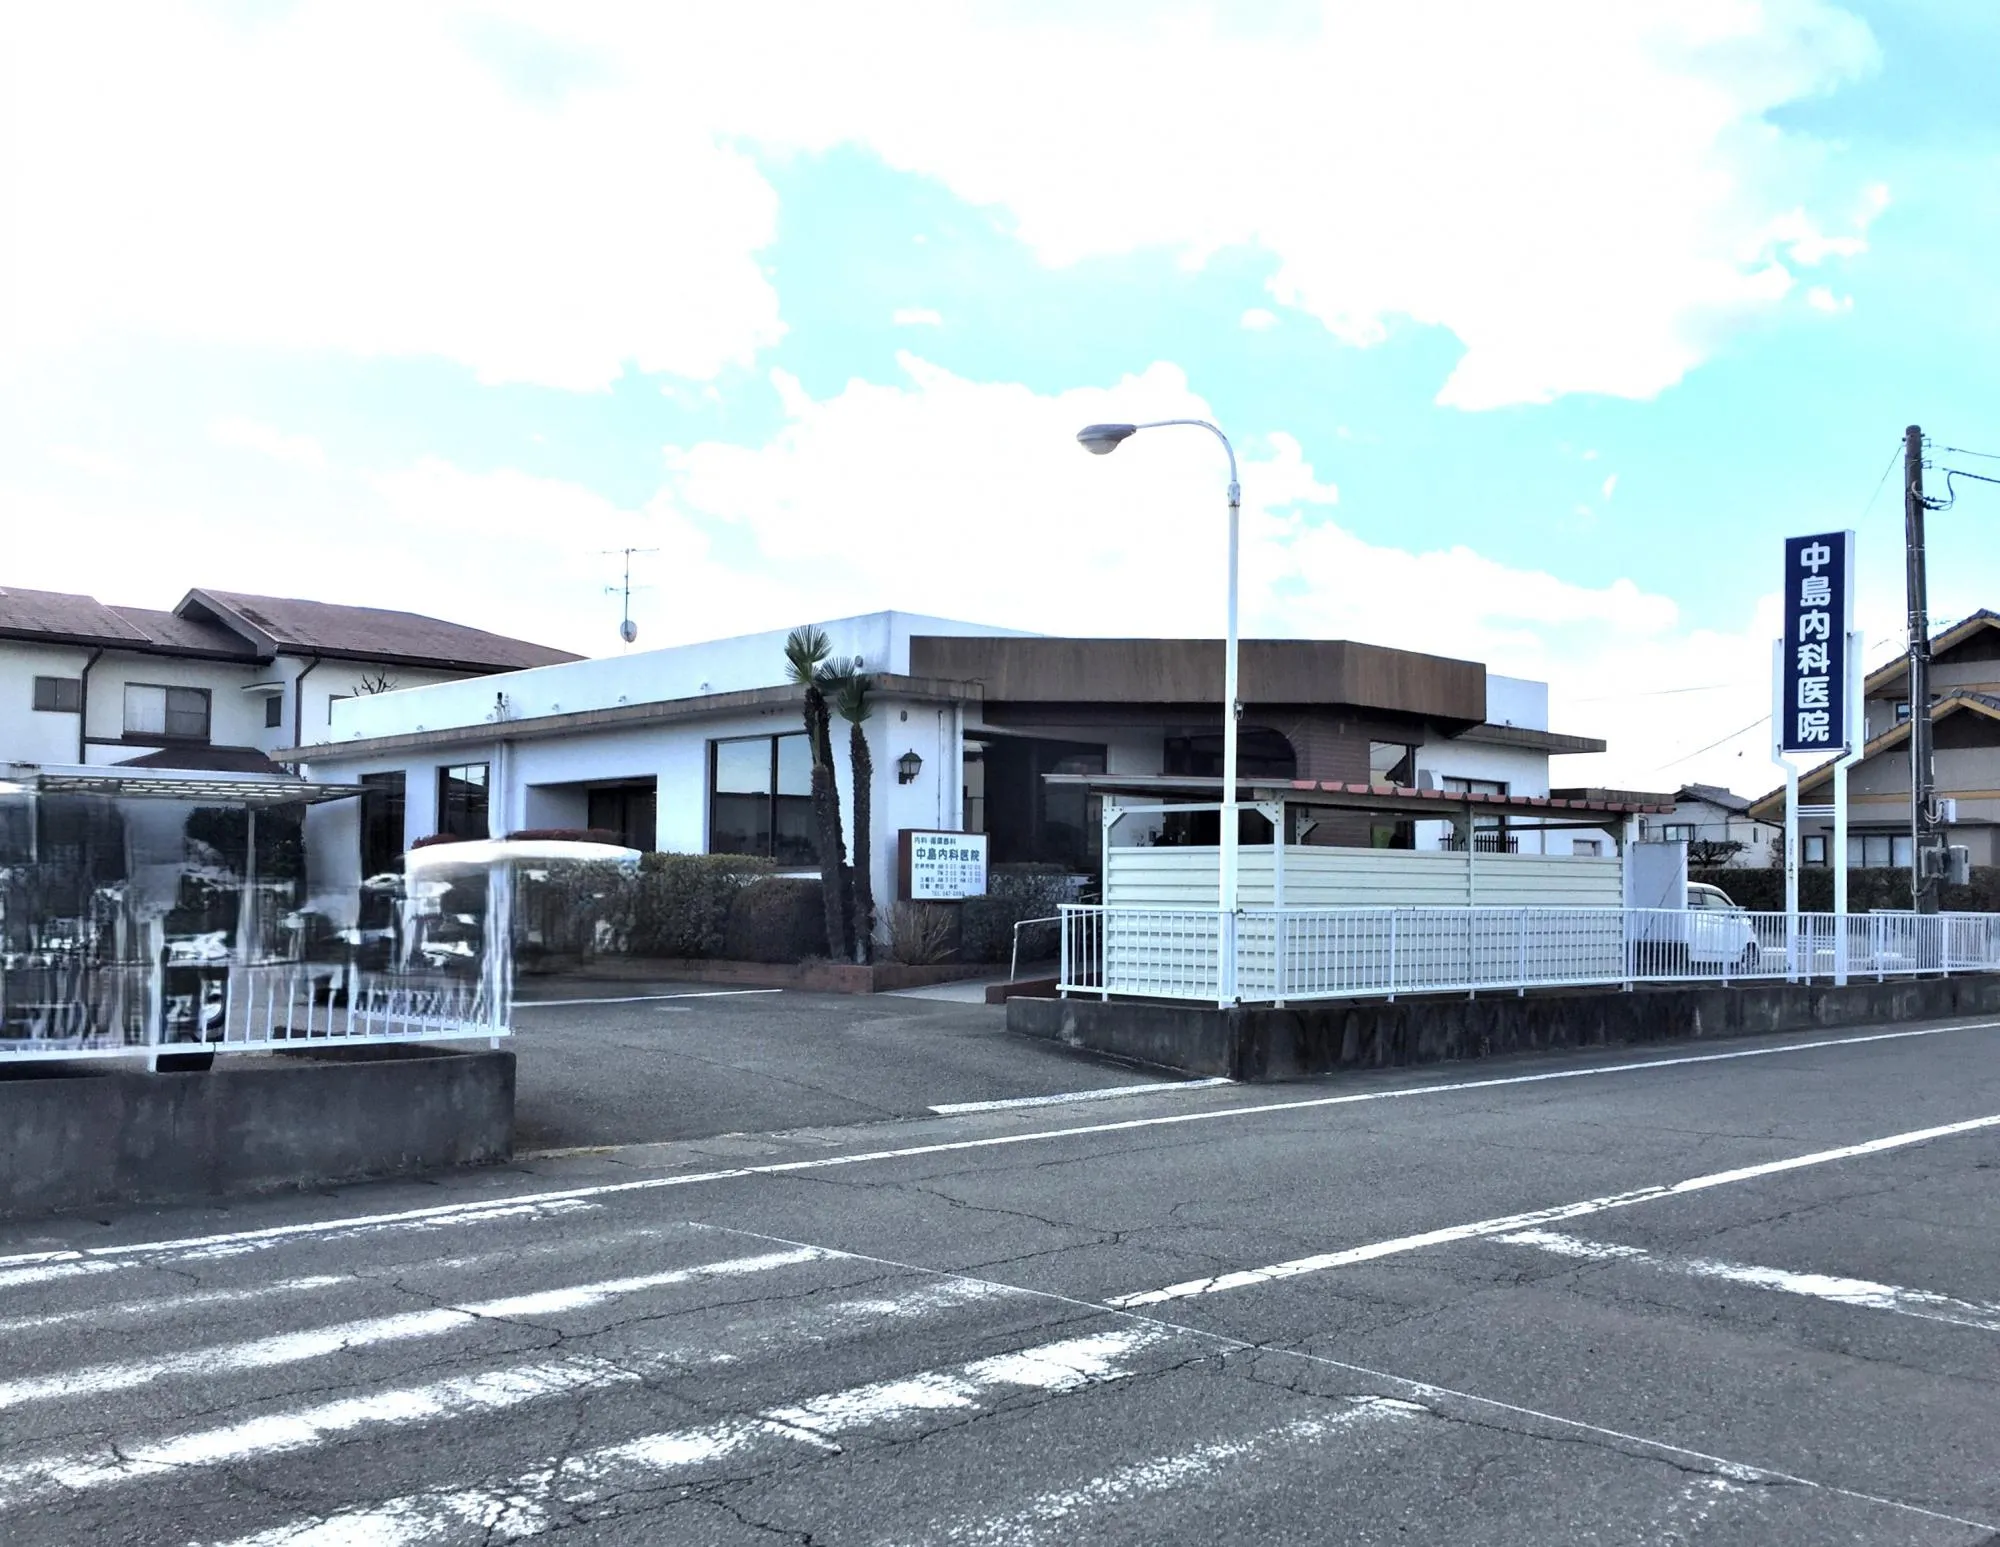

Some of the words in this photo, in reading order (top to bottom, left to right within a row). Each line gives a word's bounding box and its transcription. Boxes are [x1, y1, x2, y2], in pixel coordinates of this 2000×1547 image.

[1797, 541, 1832, 743] 中島内科医院
[916, 847, 980, 862] 中島内科医院
